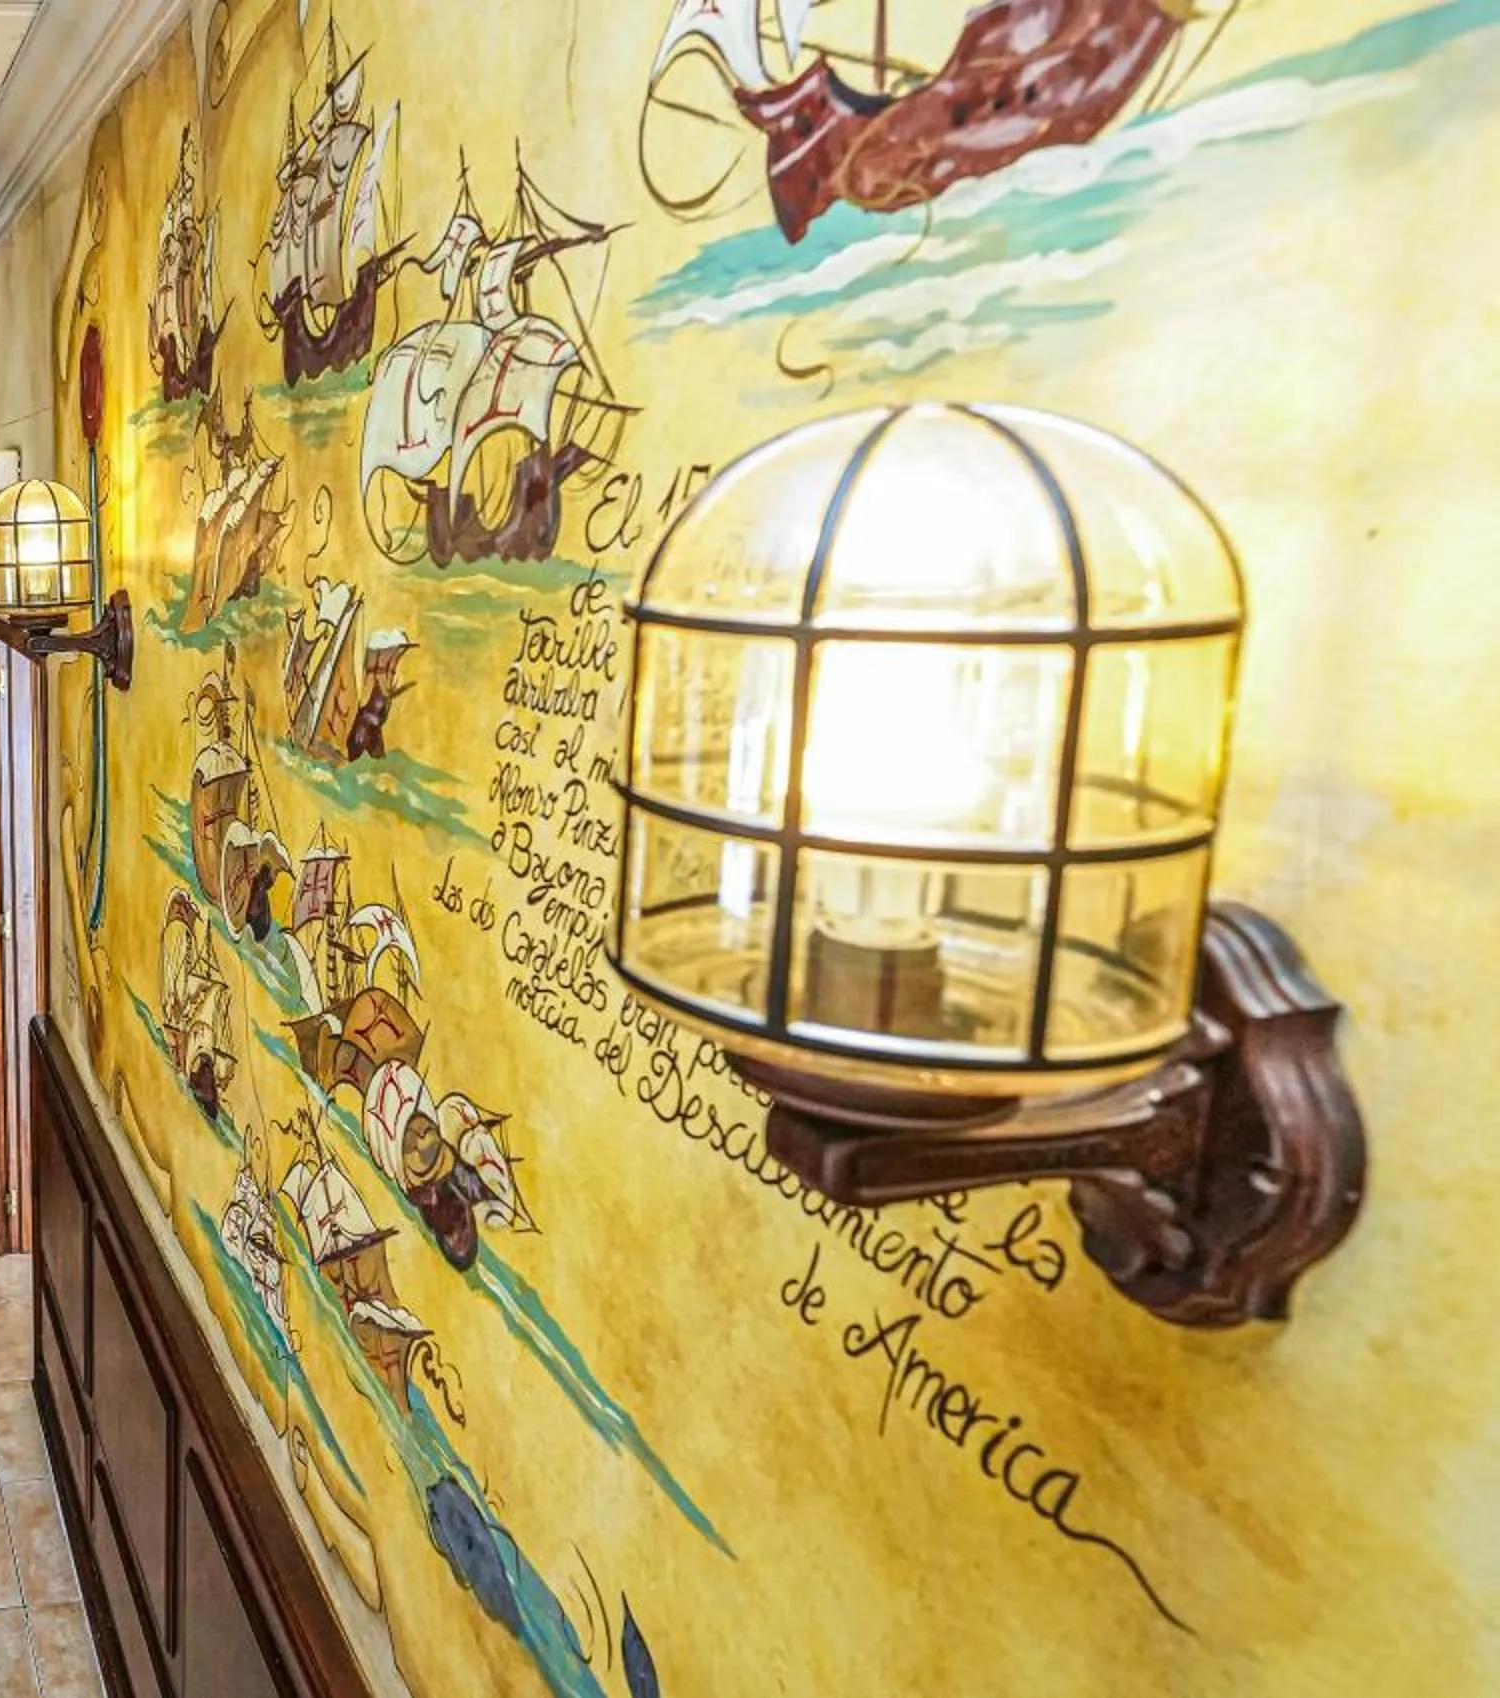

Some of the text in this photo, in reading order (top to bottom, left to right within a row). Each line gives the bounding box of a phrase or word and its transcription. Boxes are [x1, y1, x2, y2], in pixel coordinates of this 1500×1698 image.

[585, 472, 643, 553] El
[570, 559, 615, 617] de
[553, 723, 585, 773] al
[509, 821, 605, 909] Bayona
[543, 896, 609, 970] empuj
[593, 1019, 633, 1097] del
[637, 1049, 1003, 1319] Descumiento
[983, 1202, 1066, 1293] la
[781, 1240, 1120, 1552] de America
